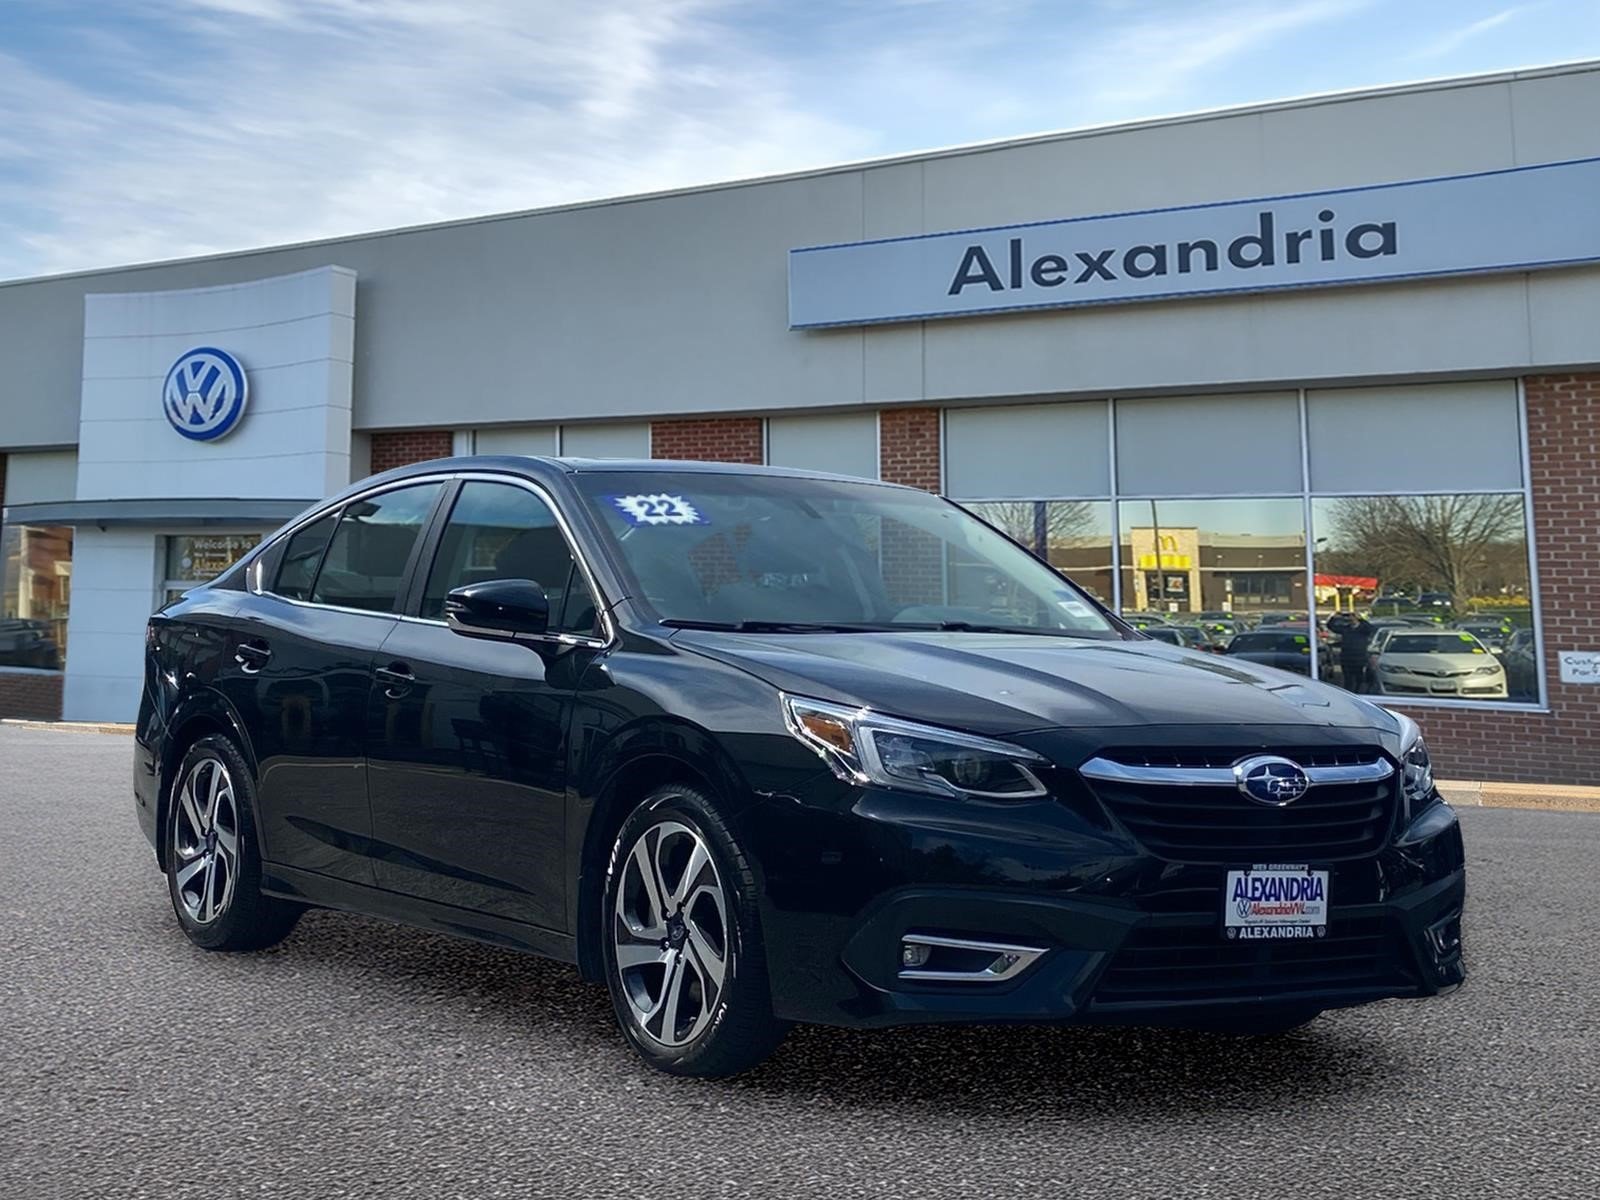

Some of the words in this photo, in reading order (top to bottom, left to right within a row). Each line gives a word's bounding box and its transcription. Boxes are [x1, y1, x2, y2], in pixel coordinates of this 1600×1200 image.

[948, 209, 1398, 296] Alexandria
[636, 500, 683, 517] 22
[1232, 877, 1324, 902] ALEXANDRIA
[1239, 927, 1314, 939] ALEXANDRIA
